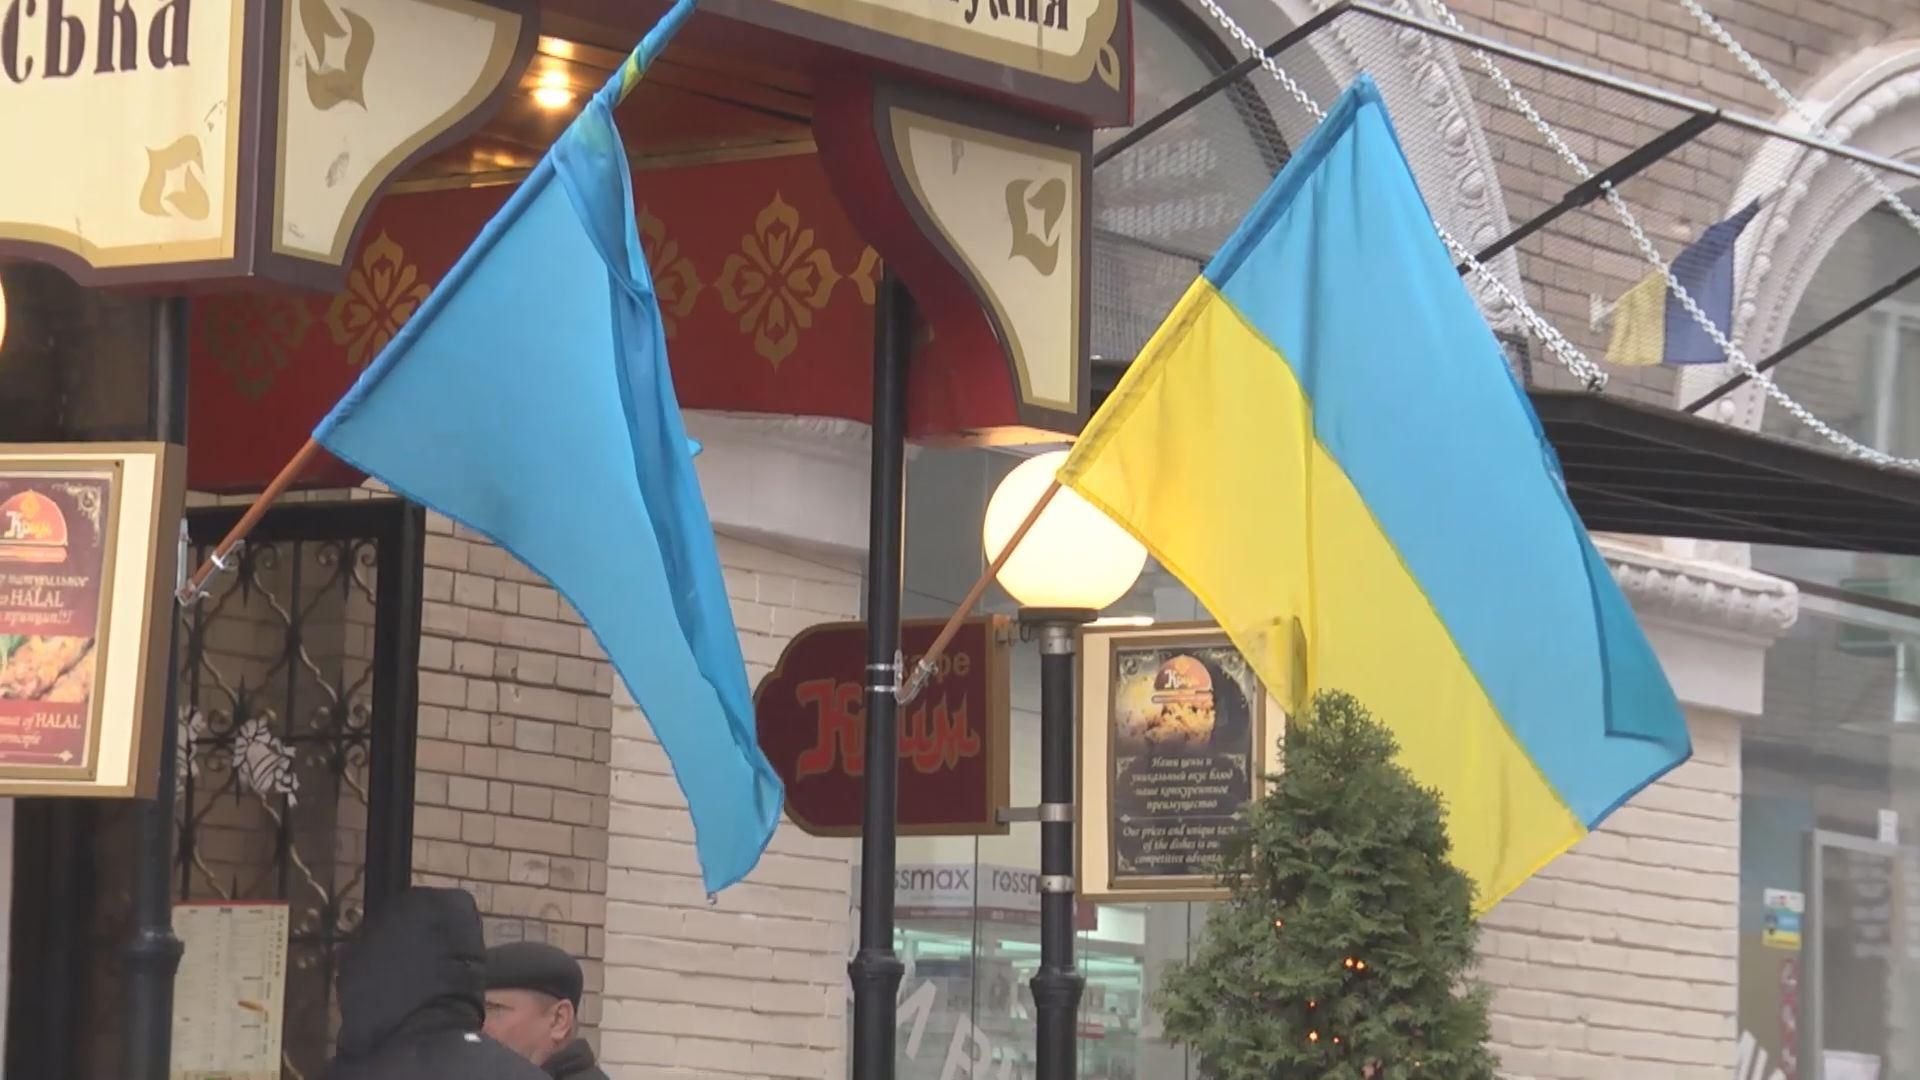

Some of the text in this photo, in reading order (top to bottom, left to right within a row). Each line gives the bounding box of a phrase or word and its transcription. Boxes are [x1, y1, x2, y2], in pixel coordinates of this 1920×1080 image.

[11, 588, 64, 608] HALAL
[36, 711, 82, 729] HALAL
[796, 678, 980, 783] Ким
[1167, 824, 1185, 836] and
[1154, 840, 1168, 849] the
[993, 870, 1042, 895] rossm
